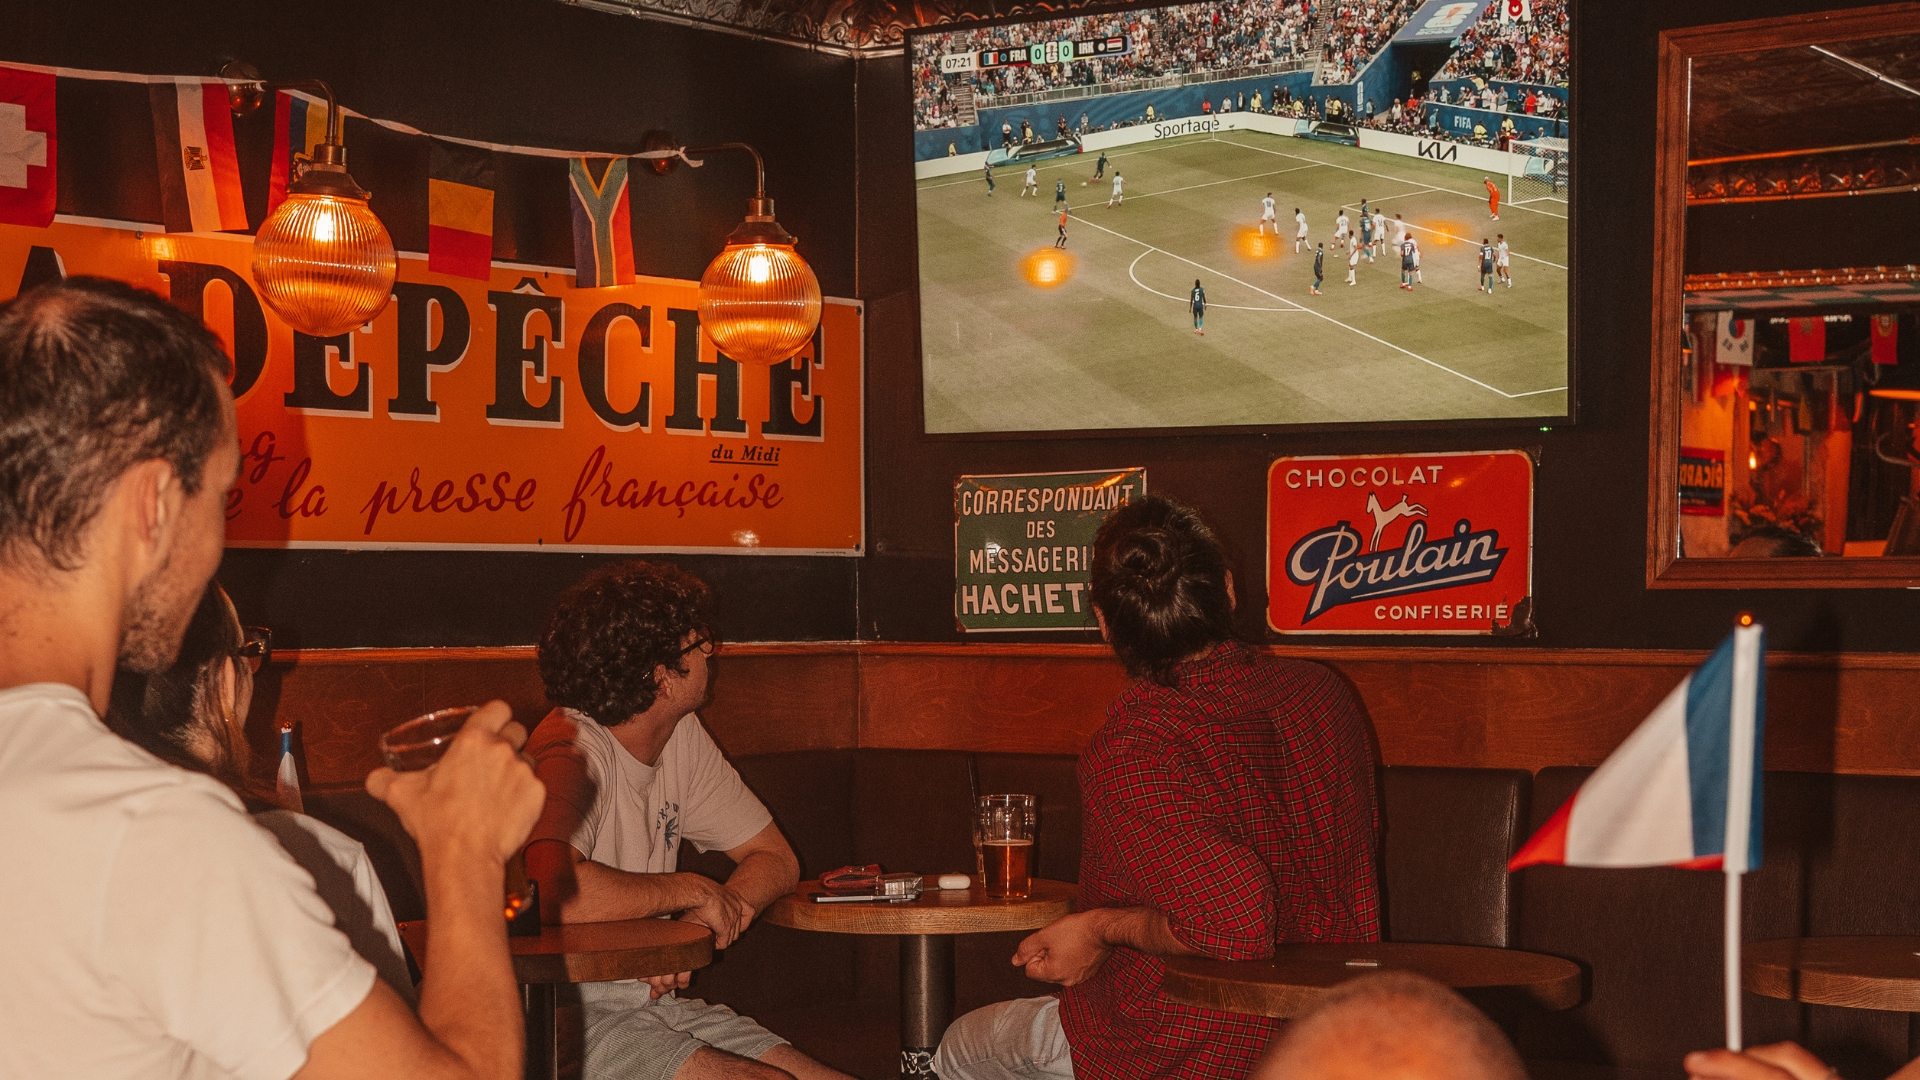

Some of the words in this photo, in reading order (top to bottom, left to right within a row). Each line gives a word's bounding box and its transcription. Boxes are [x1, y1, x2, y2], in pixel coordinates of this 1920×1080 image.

[945, 57, 972, 69] 07:21
[1009, 49, 1027, 62] FRA
[1034, 48, 1042, 60] 0
[1062, 45, 1070, 57] 0
[1078, 42, 1095, 55] IRK
[1454, 115, 1472, 130] FIFA
[711, 443, 733, 459] du
[741, 445, 780, 462] Midi
[1285, 465, 1444, 489] CHOCOLAT
[272, 457, 328, 519] la
[360, 467, 537, 535] presse
[562, 445, 784, 542] française
[962, 484, 1134, 516] CORRESPONDANT
[1026, 520, 1056, 539] DES
[969, 545, 1090, 574] MESSAGERI
[1290, 523, 1500, 616] Poulain
[961, 582, 1092, 615] HACHET
[1374, 604, 1509, 620] CONFISERIE
